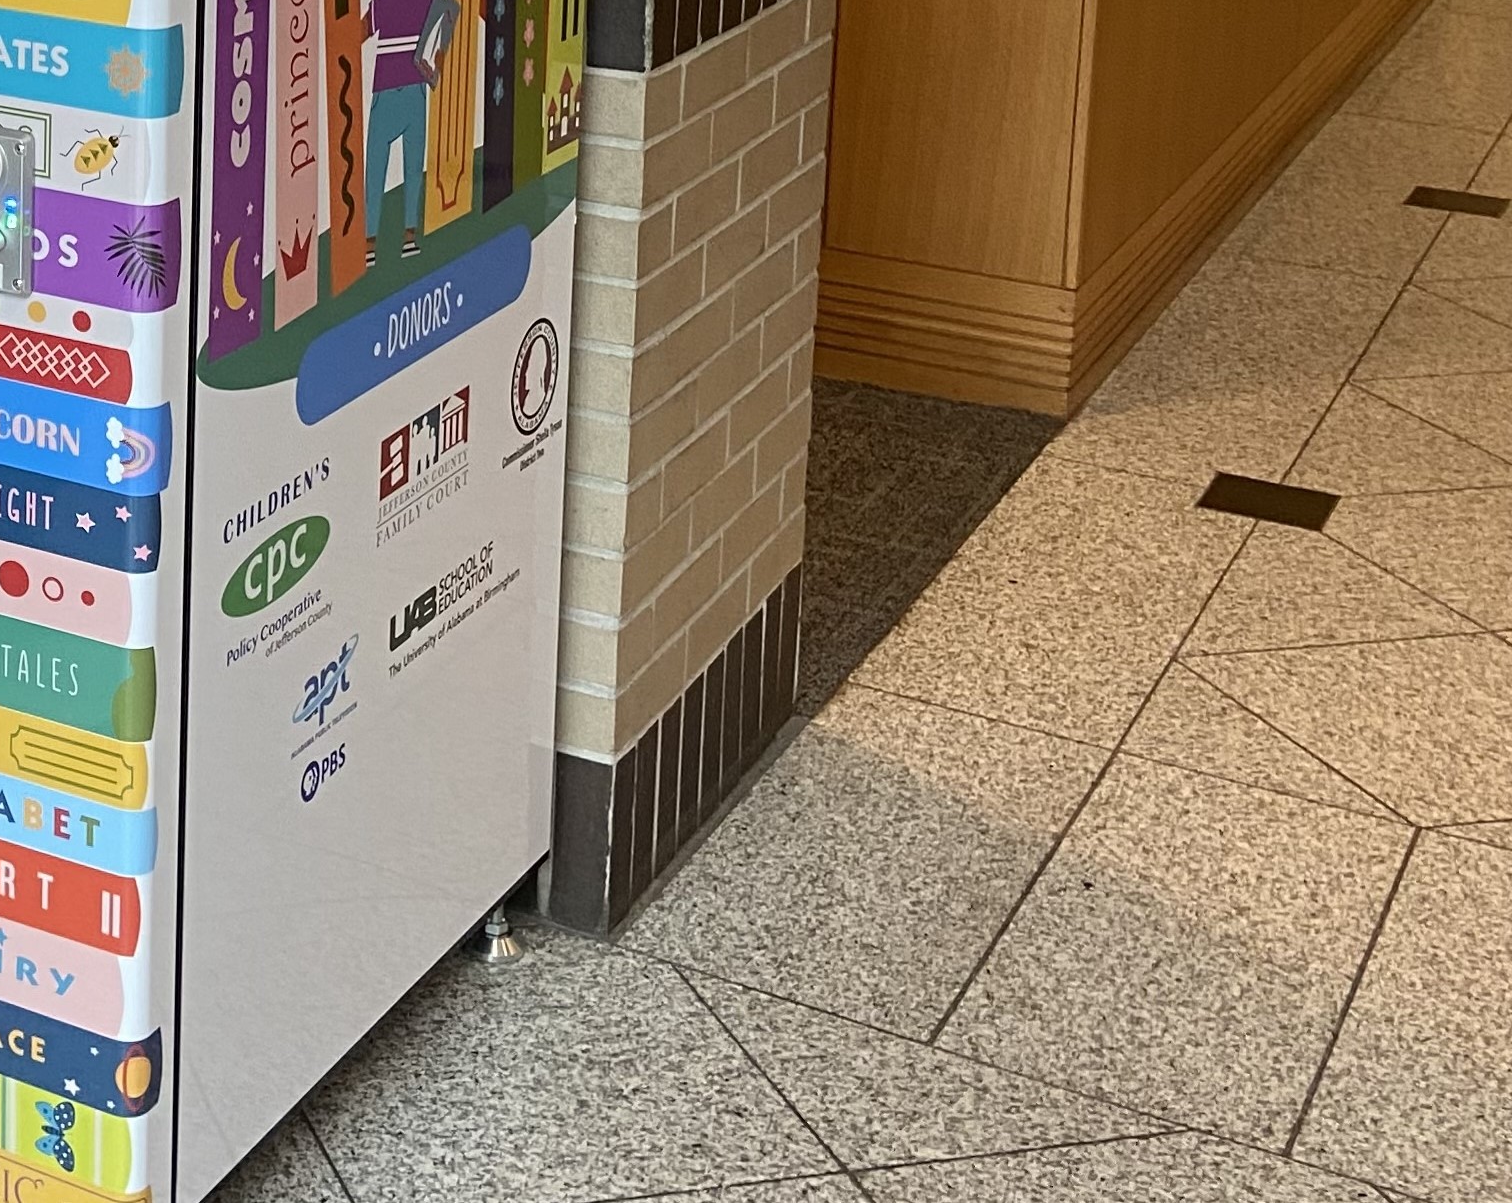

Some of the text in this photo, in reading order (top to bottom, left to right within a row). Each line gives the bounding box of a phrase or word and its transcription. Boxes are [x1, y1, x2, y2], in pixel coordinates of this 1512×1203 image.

[388, 281, 451, 357] DONORS
[223, 457, 330, 545] CHILDREN'S
[376, 468, 469, 549] FAMILY COURT
[377, 448, 469, 524] JEFFERSON COUNTY
[244, 523, 308, 603] cpc
[438, 540, 494, 596] SCHOOL OF
[438, 559, 493, 615] EDUCATION
[226, 589, 322, 668] Policy Cooperative
[265, 602, 333, 659] of Jefferson County
[388, 568, 520, 678] The University of Alabama at Birmingham
[389, 585, 437, 653] UAB
[0, 643, 80, 697] TALES
[303, 641, 352, 727] apt
[321, 742, 346, 784] PBS
